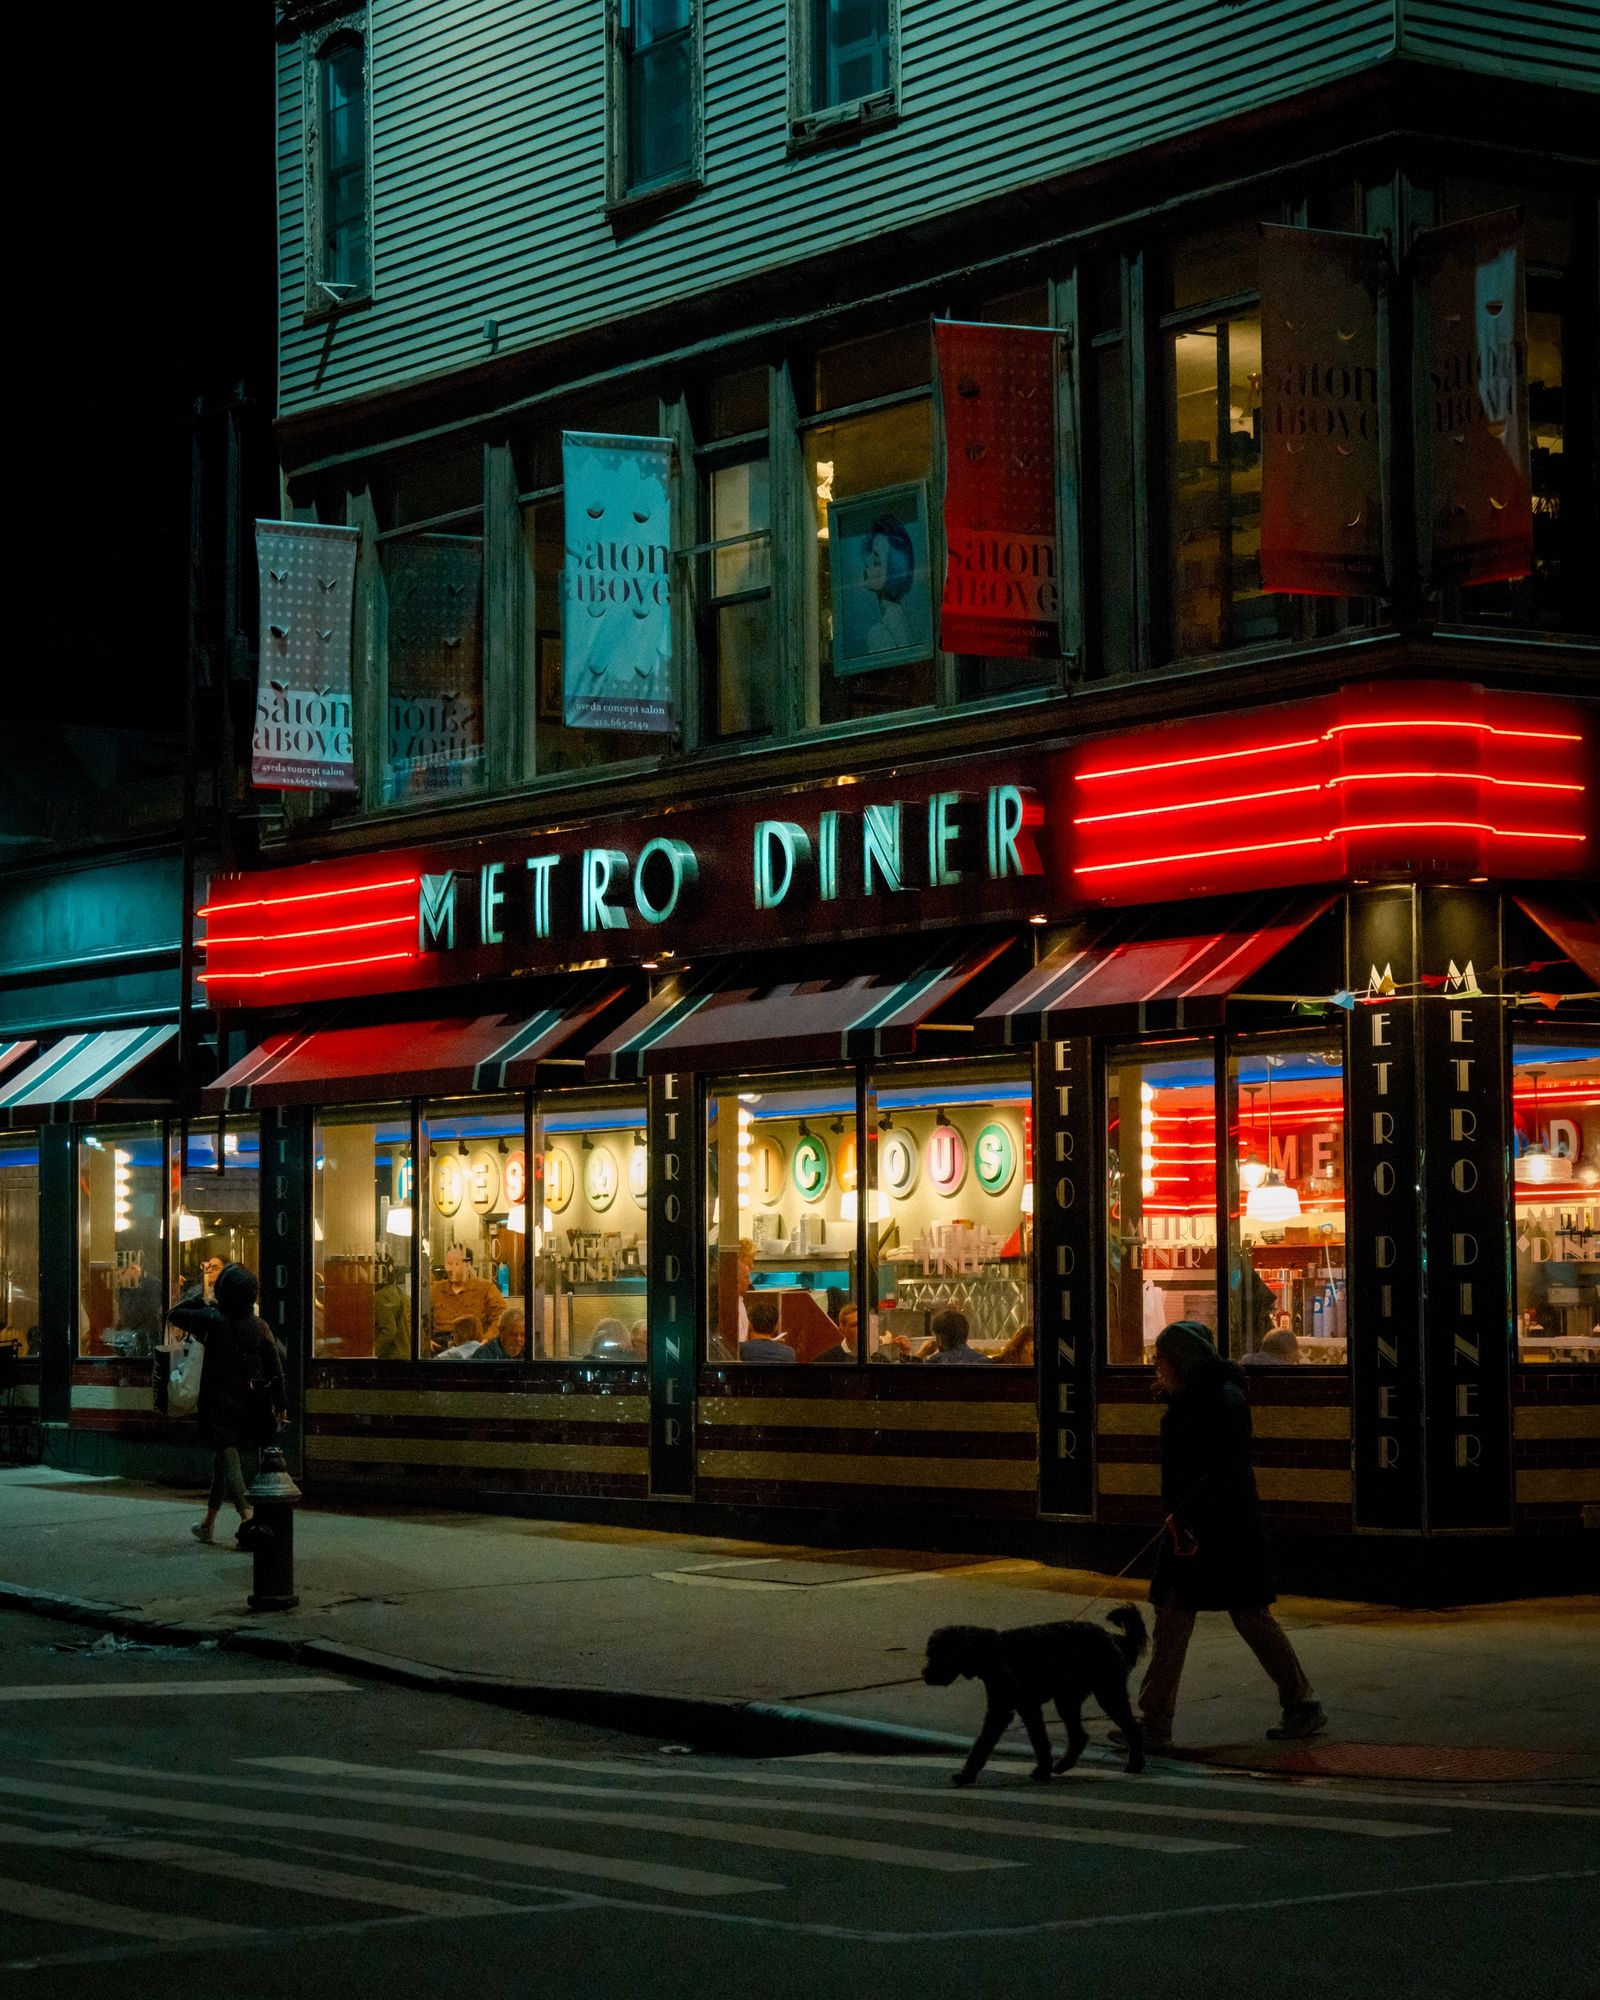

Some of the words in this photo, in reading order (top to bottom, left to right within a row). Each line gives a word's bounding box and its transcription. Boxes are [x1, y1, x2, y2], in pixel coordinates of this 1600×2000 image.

[565, 541, 668, 574] salon
[948, 541, 1056, 576] salon
[253, 727, 352, 757] above
[257, 697, 350, 728] salon
[262, 763, 286, 772] aveda
[287, 765, 320, 776] concept
[322, 767, 344, 776] salon
[603, 704, 638, 715] concept
[641, 705, 665, 715] salon
[419, 837, 690, 952] METRO
[754, 785, 1028, 910] DINER
[1056, 1041, 1075, 1210] ETRO
[1367, 961, 1397, 1196] METRO
[1442, 958, 1479, 1193] METRO
[274, 1104, 288, 1236] ETRO
[665, 1074, 680, 1223] ETRO
[567, 1261, 620, 1283] DINER
[1129, 1215, 1206, 1241] METRO
[1130, 1244, 1200, 1270] DINER
[665, 1255, 680, 1447] DINER
[1057, 1245, 1076, 1460] DINER
[1375, 1236, 1399, 1469] DINER
[1452, 1234, 1480, 1467] DINER
